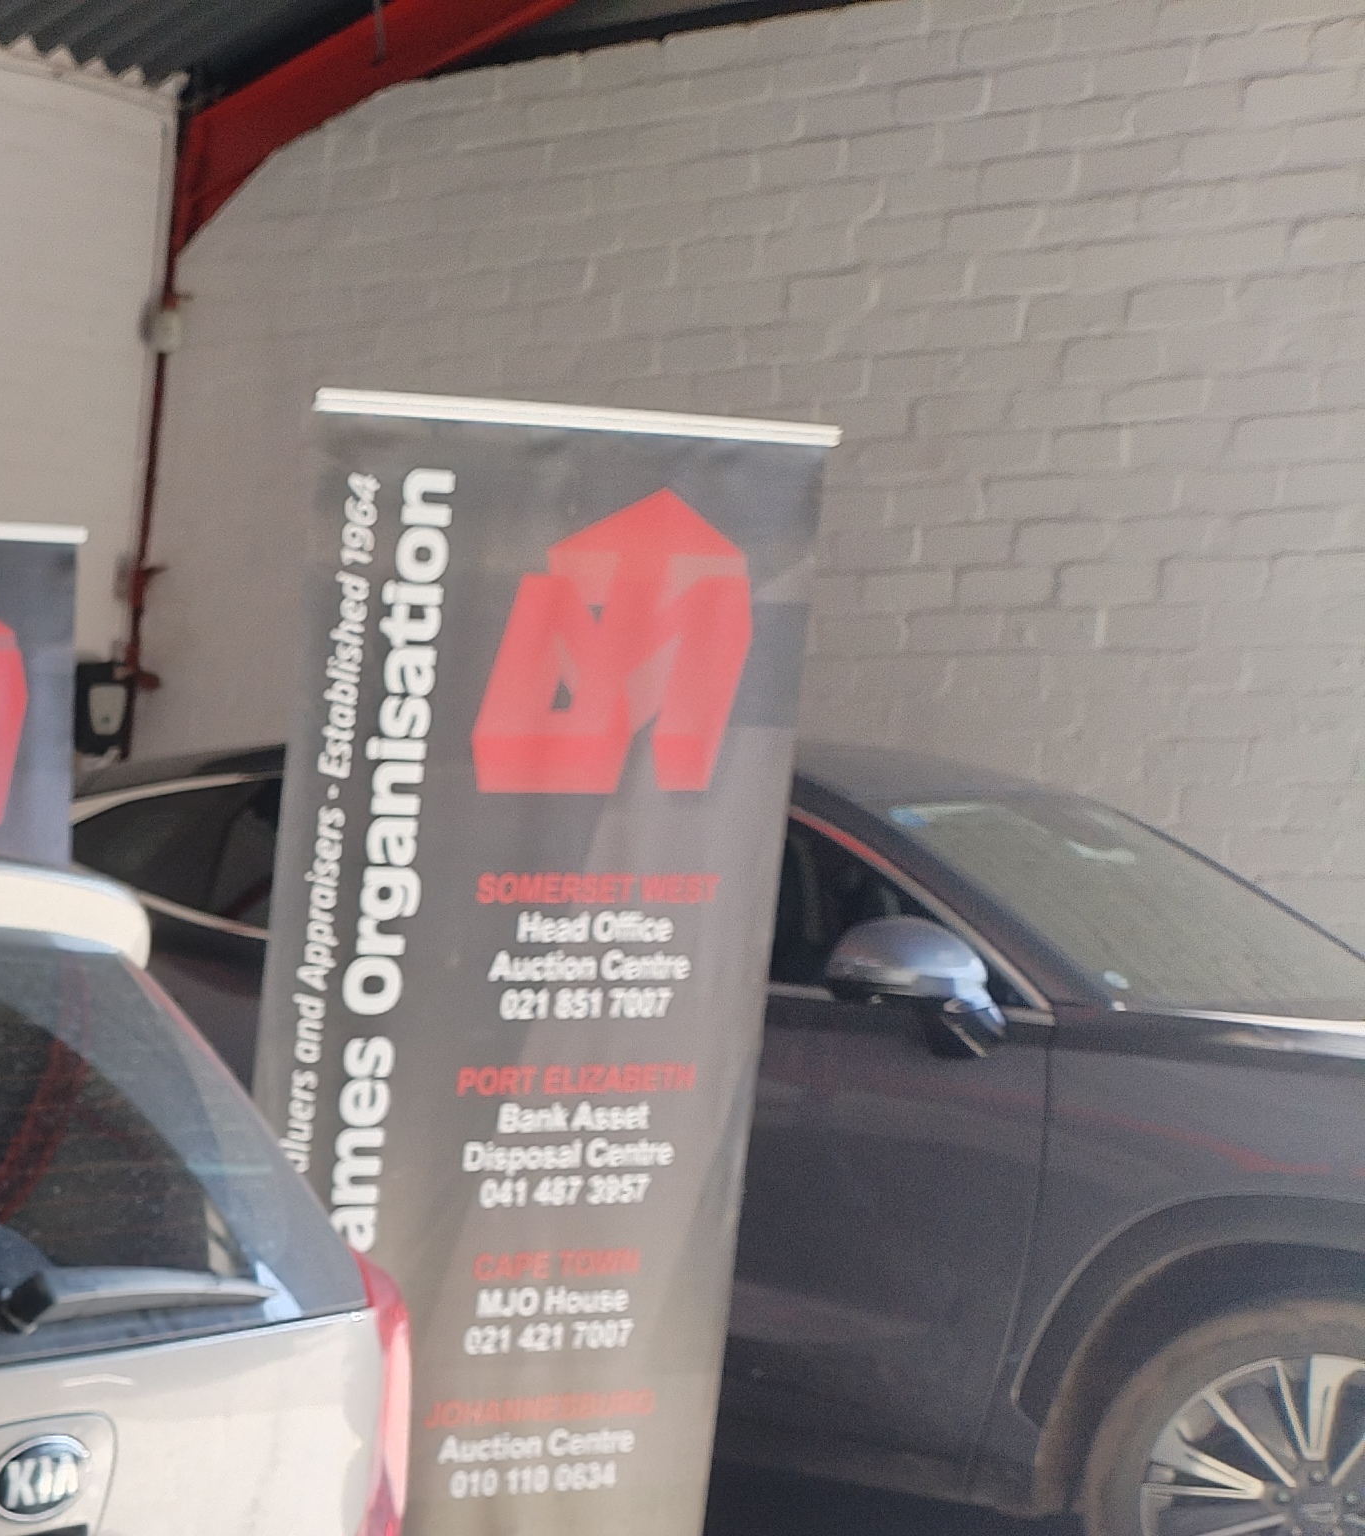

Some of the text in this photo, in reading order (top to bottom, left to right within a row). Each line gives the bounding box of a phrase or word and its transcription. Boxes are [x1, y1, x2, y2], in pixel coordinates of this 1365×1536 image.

[340, 472, 380, 566] 1964
[318, 569, 370, 779] Established
[342, 468, 456, 1015] Organisation
[296, 806, 346, 991] Appraisers
[476, 872, 720, 904] SOMERSET WEST
[516, 910, 674, 943] Head Office
[487, 949, 692, 982] Auction Centre
[500, 986, 674, 1020] 021 851 7007
[292, 993, 327, 1064] and
[456, 1061, 697, 1097] PORT ELIZABETH
[497, 1100, 651, 1134] Bank Asset
[462, 1137, 675, 1177] Disposal Centre
[479, 1177, 528, 1209] 041
[472, 1252, 550, 1282] CAPE
[476, 1285, 630, 1319] MJO House
[464, 1317, 636, 1356] 021 421 7007
[437, 1427, 635, 1465] Auction Centre
[6, 1452, 79, 1509] KIA
[449, 1467, 500, 1499] 010
[506, 1464, 550, 1495] 110
